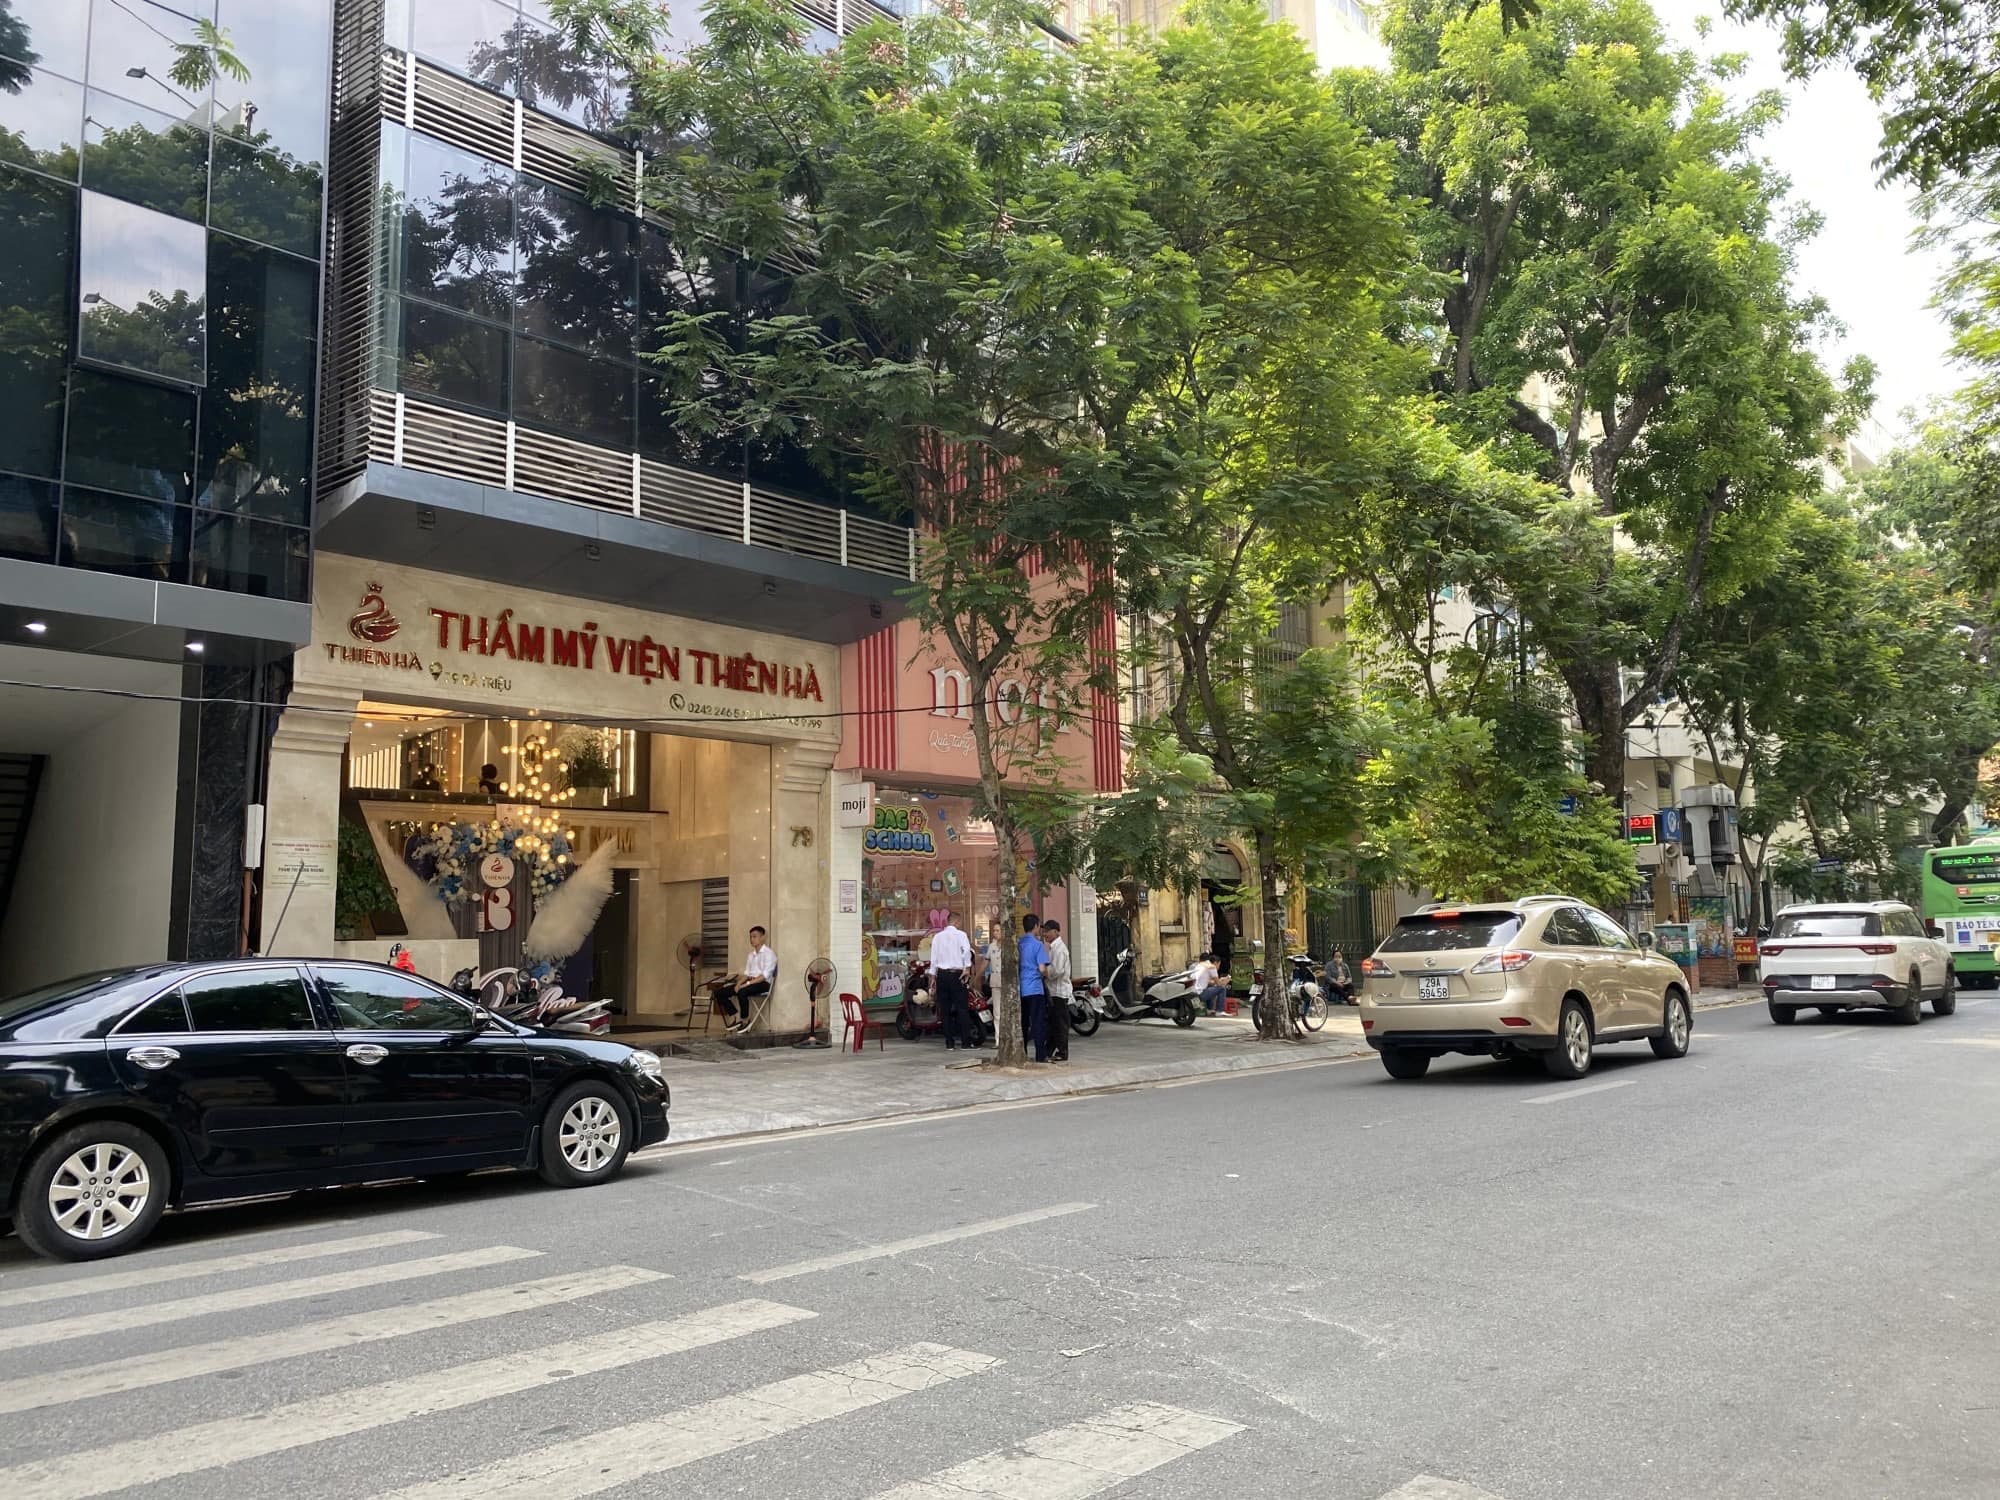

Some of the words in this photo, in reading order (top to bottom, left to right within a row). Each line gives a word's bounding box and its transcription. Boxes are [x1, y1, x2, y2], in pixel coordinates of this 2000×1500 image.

[551, 621, 599, 669] MỸ
[605, 634, 680, 686] VIỆN
[687, 649, 777, 696] THIÊN
[781, 661, 823, 703] HÀ
[842, 797, 867, 814] moji
[874, 808, 909, 830] BAG
[865, 830, 934, 853] SCHOOL
[1425, 977, 1441, 988] 29A
